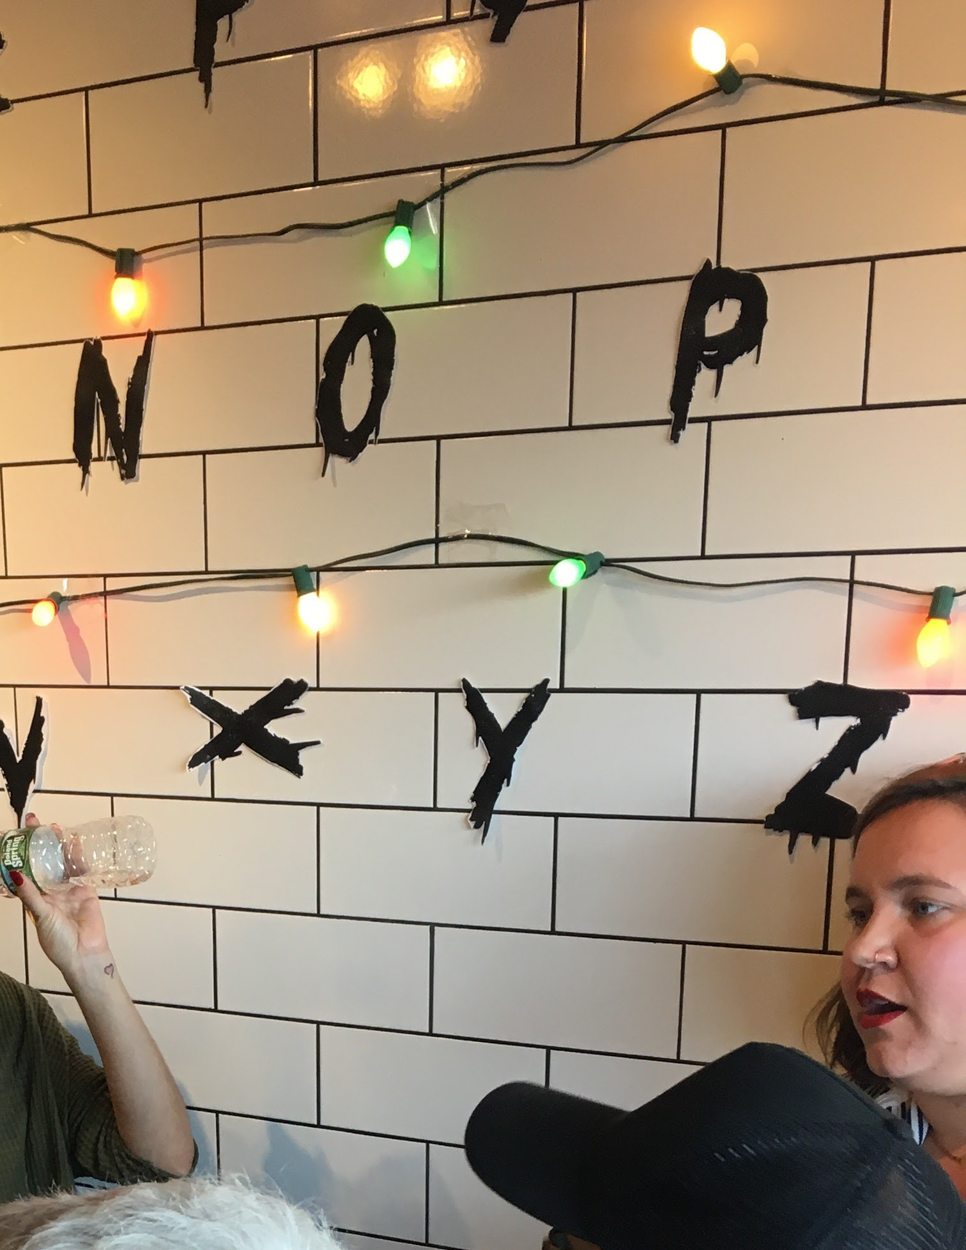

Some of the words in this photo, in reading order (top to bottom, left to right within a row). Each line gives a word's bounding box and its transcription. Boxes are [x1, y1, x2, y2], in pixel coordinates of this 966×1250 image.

[72, 330, 153, 487] N
[315, 303, 397, 475] O
[669, 258, 769, 443] P
[180, 678, 321, 778] X
[462, 678, 551, 844] Y
[764, 680, 911, 853] Z
[4, 840, 12, 865] Poland
[11, 835, 25, 868] Spring
